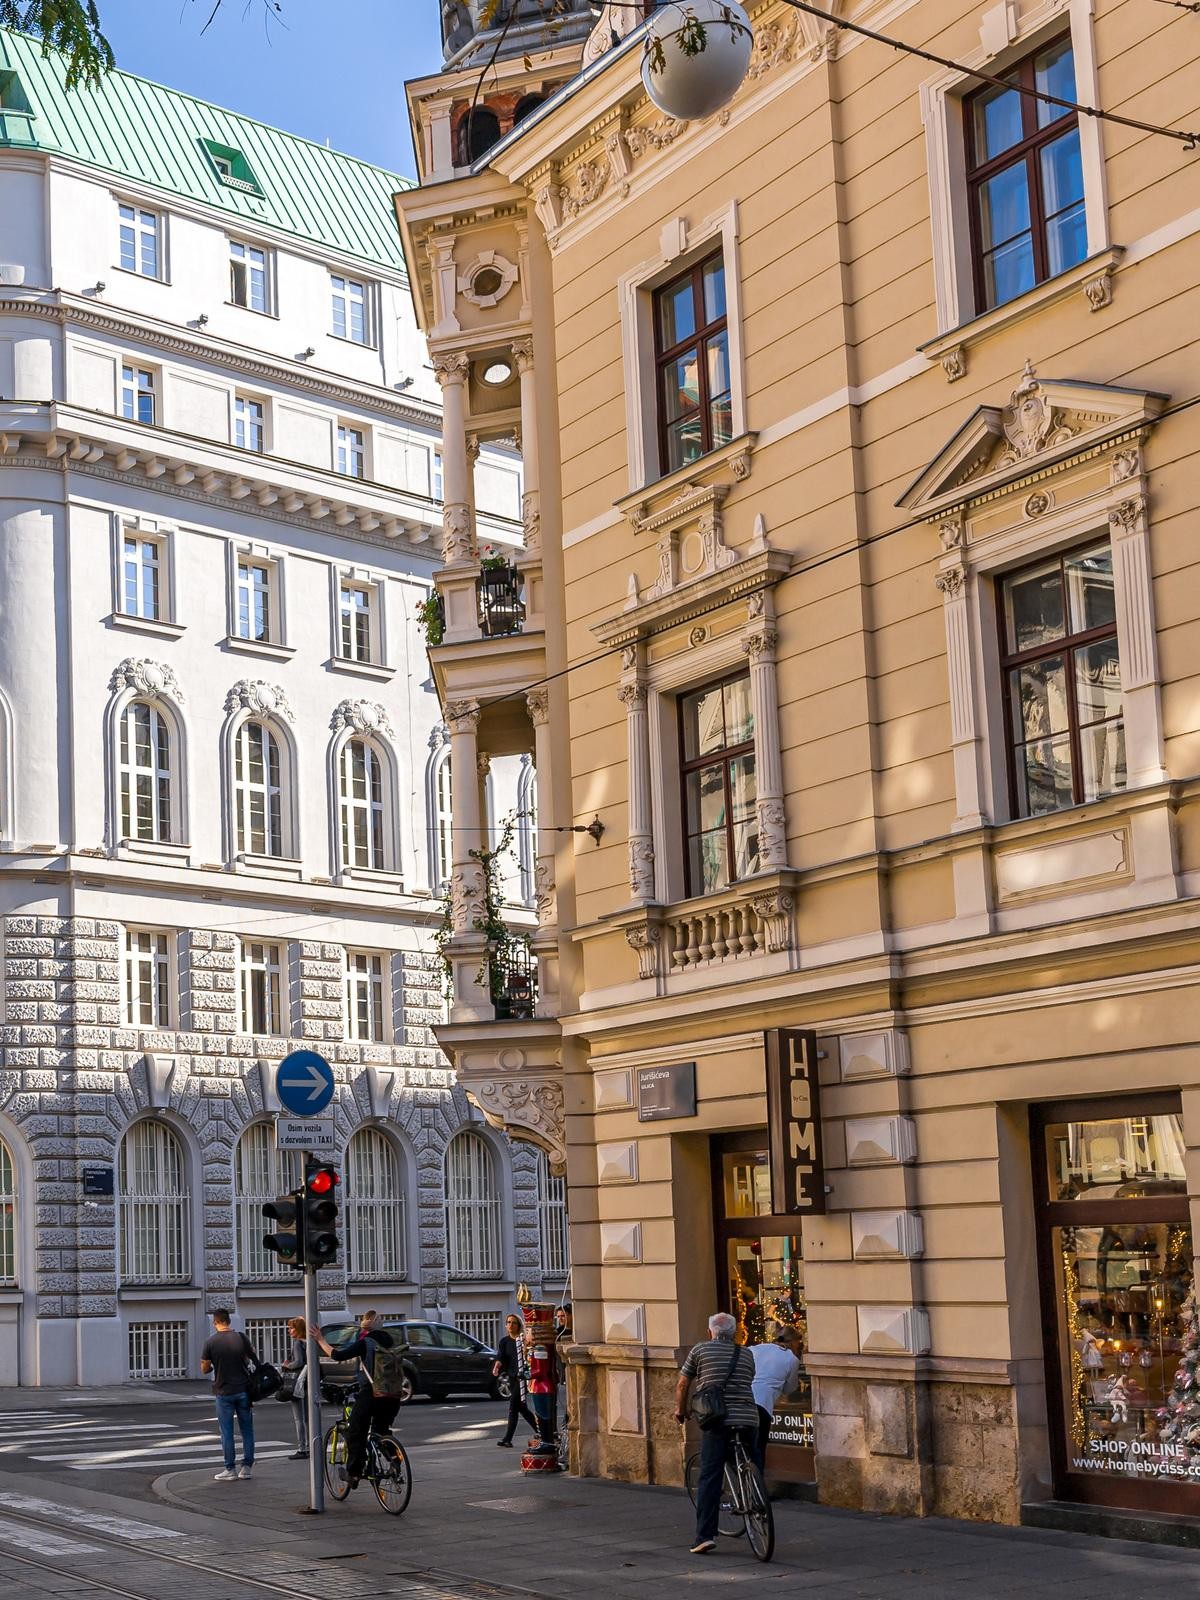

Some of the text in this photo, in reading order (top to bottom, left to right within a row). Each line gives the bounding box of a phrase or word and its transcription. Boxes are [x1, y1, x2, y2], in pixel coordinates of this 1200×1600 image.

[287, 1123, 322, 1131] Osim vozila
[788, 1038, 816, 1206] HOME
[318, 1135, 332, 1144] TAXI
[1090, 1440, 1184, 1457] SHOP ONLINE
